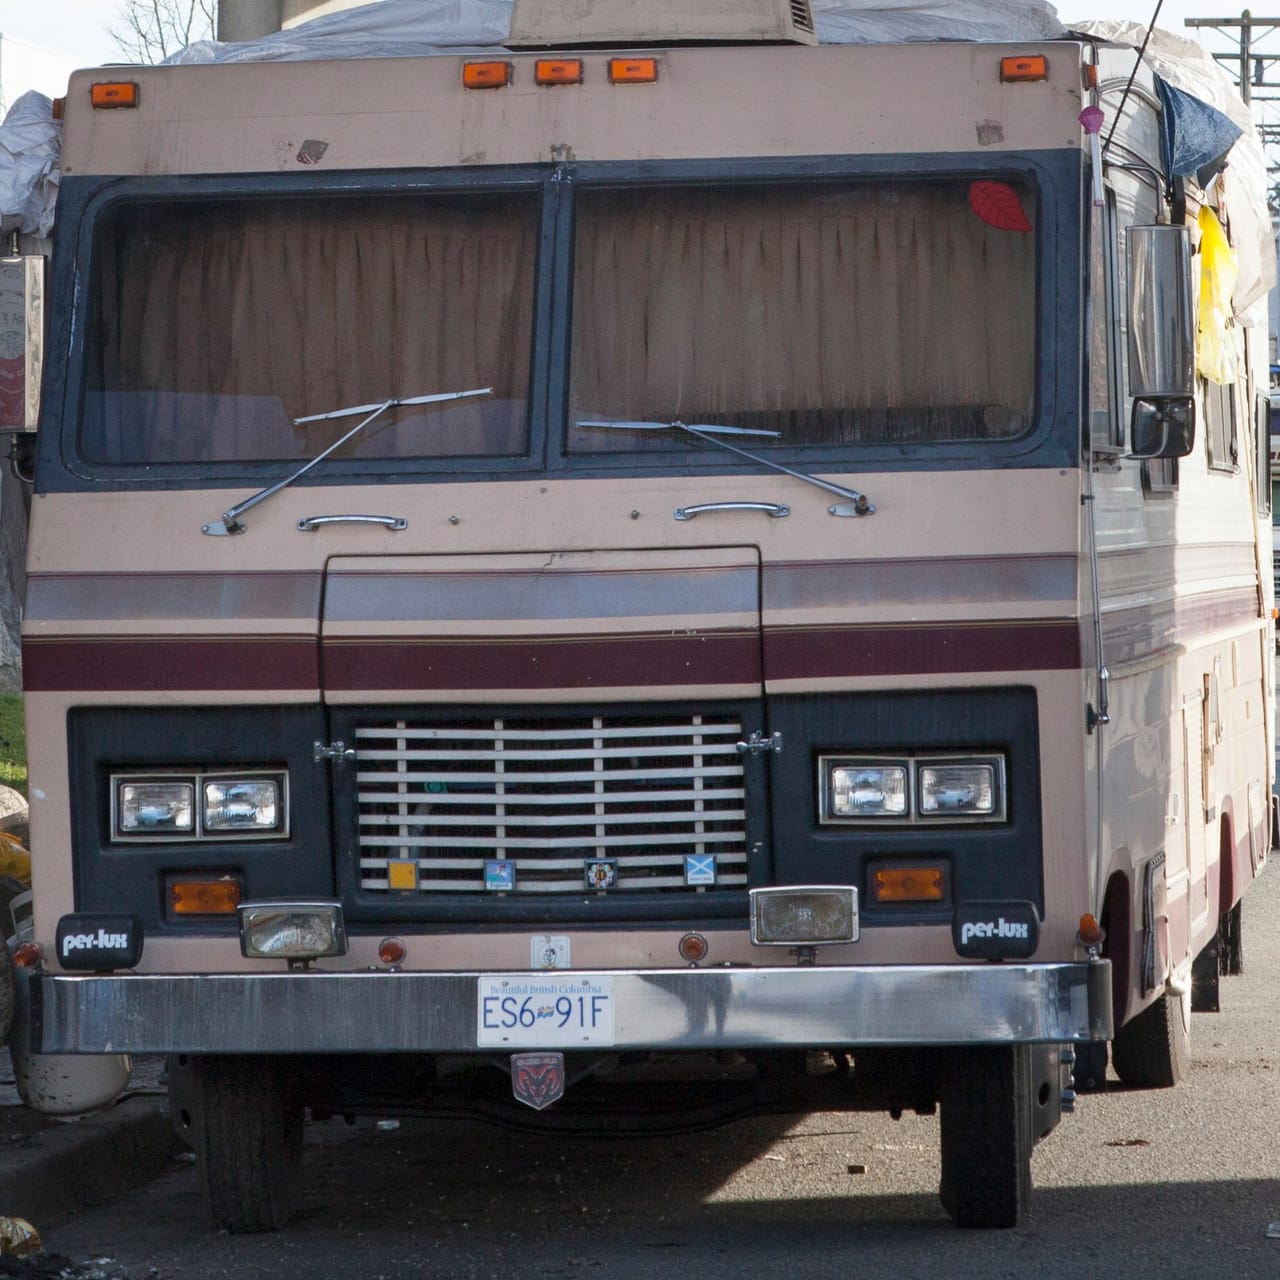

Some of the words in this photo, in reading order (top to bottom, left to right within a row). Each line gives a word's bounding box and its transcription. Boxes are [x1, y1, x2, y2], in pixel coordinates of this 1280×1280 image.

[63, 929, 128, 957] per-lux
[962, 918, 1028, 945] per-lux
[530, 985, 558, 994] British
[559, 984, 602, 994] Columbia
[483, 996, 536, 1029] ES6
[555, 996, 608, 1029] 91F
